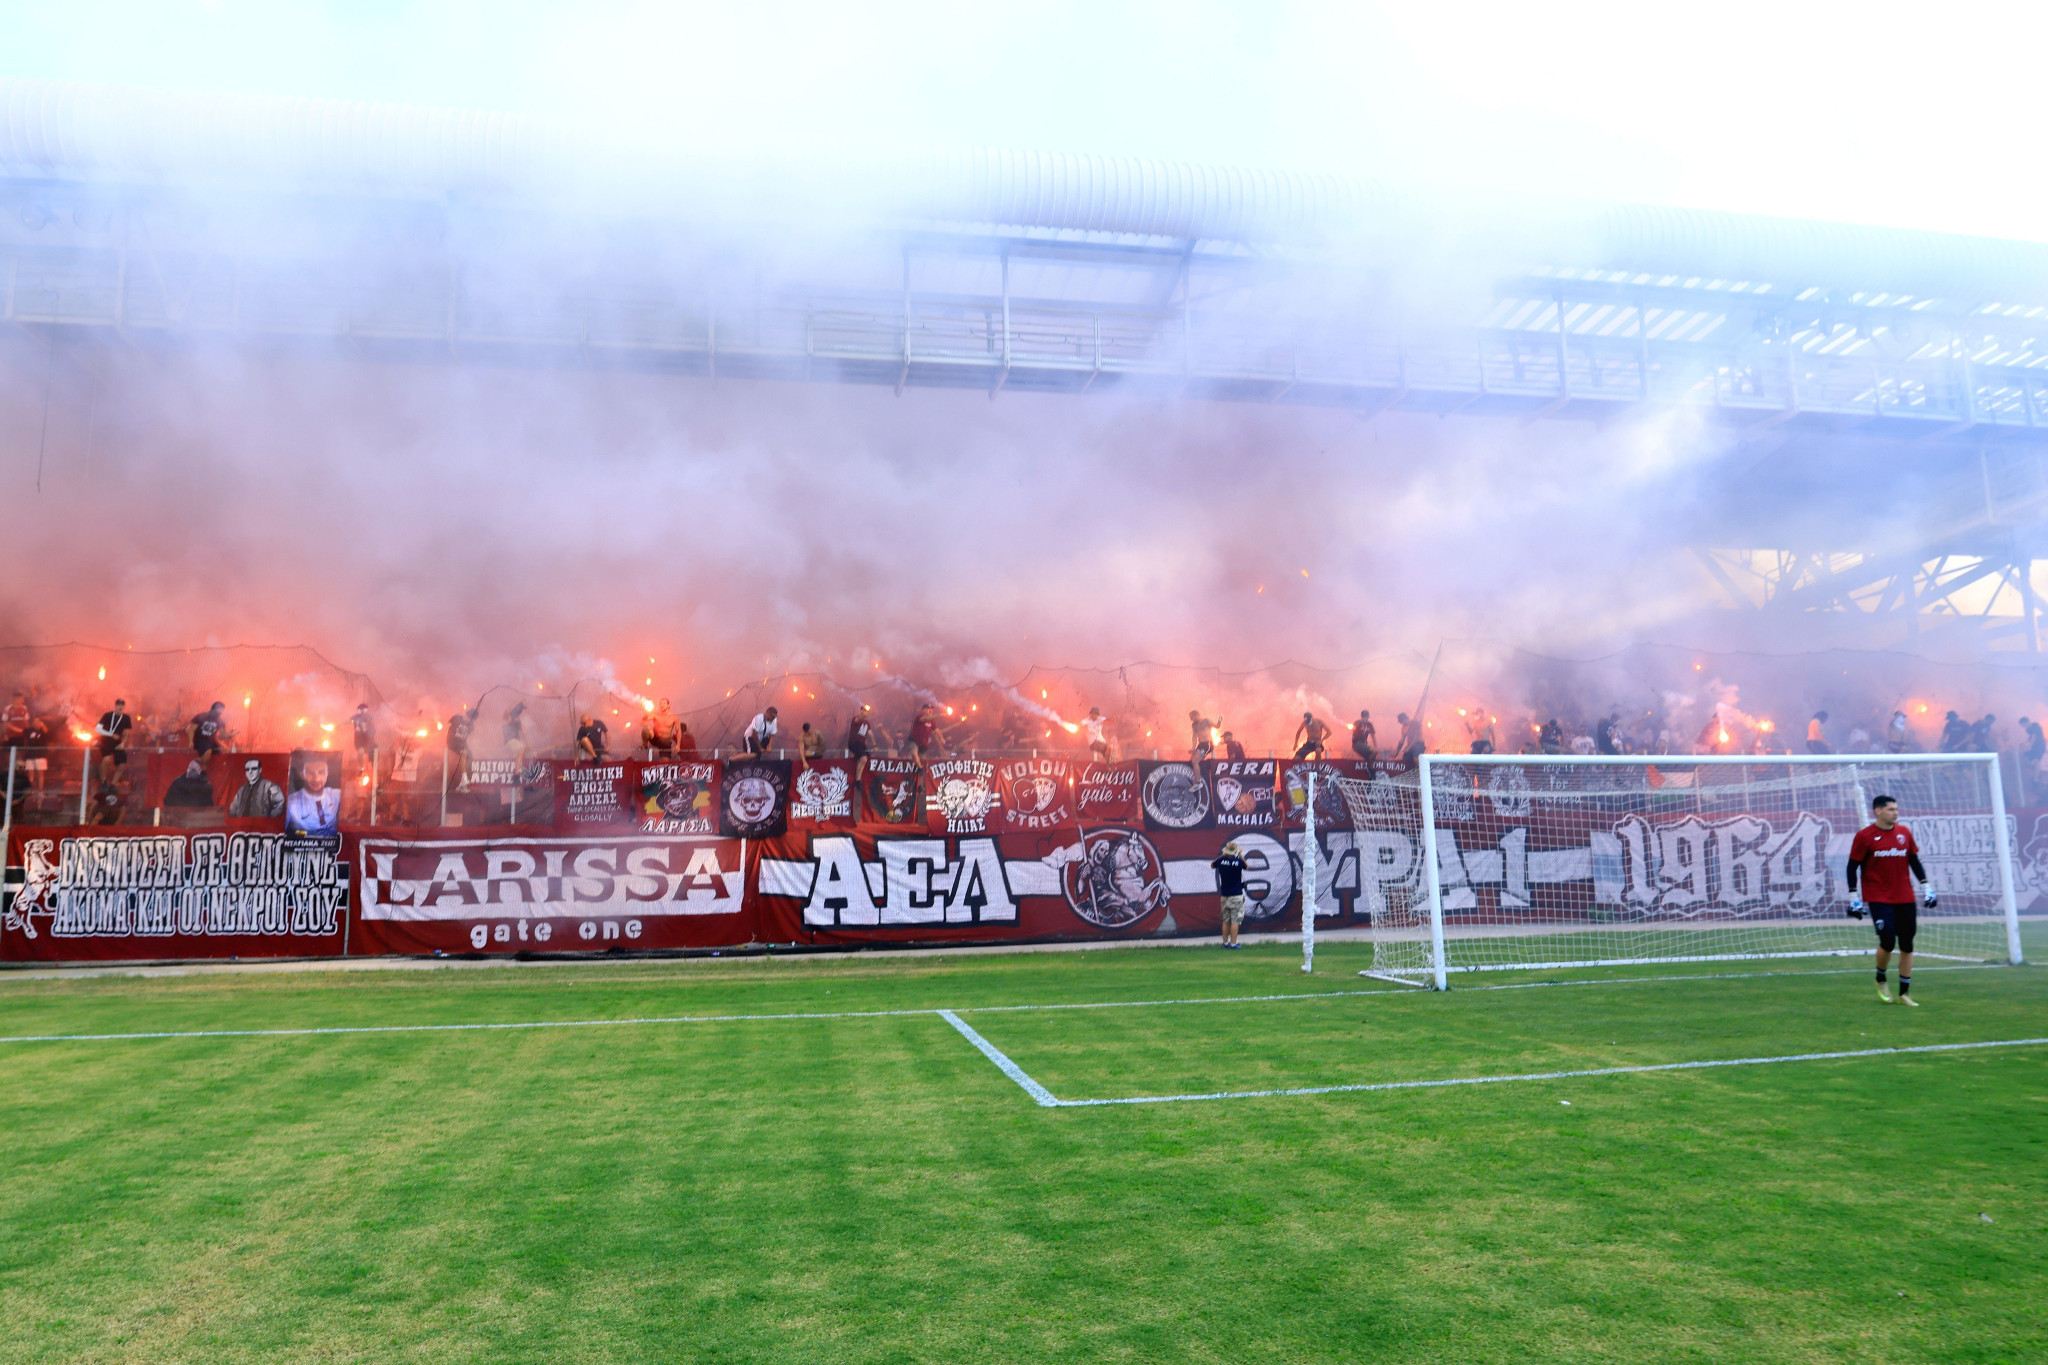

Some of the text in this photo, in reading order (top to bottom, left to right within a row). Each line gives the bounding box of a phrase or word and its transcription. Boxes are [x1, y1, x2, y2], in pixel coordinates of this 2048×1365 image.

[562, 766, 624, 781] ΑΘΛΗΤΙΚΗ
[929, 760, 995, 779] ΠΡΟΦΗΤΗΣ
[1000, 759, 1067, 781] VOLOU
[1079, 763, 1136, 785] Larissa
[1215, 761, 1274, 776] PERA
[573, 780, 613, 794] ΕΝΩΣΗ
[569, 792, 617, 806] ΛΑΡΙΣΑΣ
[1077, 786, 1114, 811] gate
[946, 818, 986, 833] ΗΛΙΑΣ
[1005, 805, 1069, 828] STREET
[59, 837, 186, 889] ΒΑΣΙΛΙΣΣΑ
[190, 835, 225, 887] ΣΕ
[1874, 847, 1907, 857] novibet
[1611, 814, 1833, 914] 1964
[370, 847, 732, 907] LARISSA
[803, 827, 1531, 926] ΑΕΛ ΘΥΡΑ 1
[52, 885, 341, 934] ΑΚΟΜΑ ΚΑΙ ΟΙ ΝΕΚΡΟΙ ΣΟΥ
[469, 918, 643, 949] gate one
